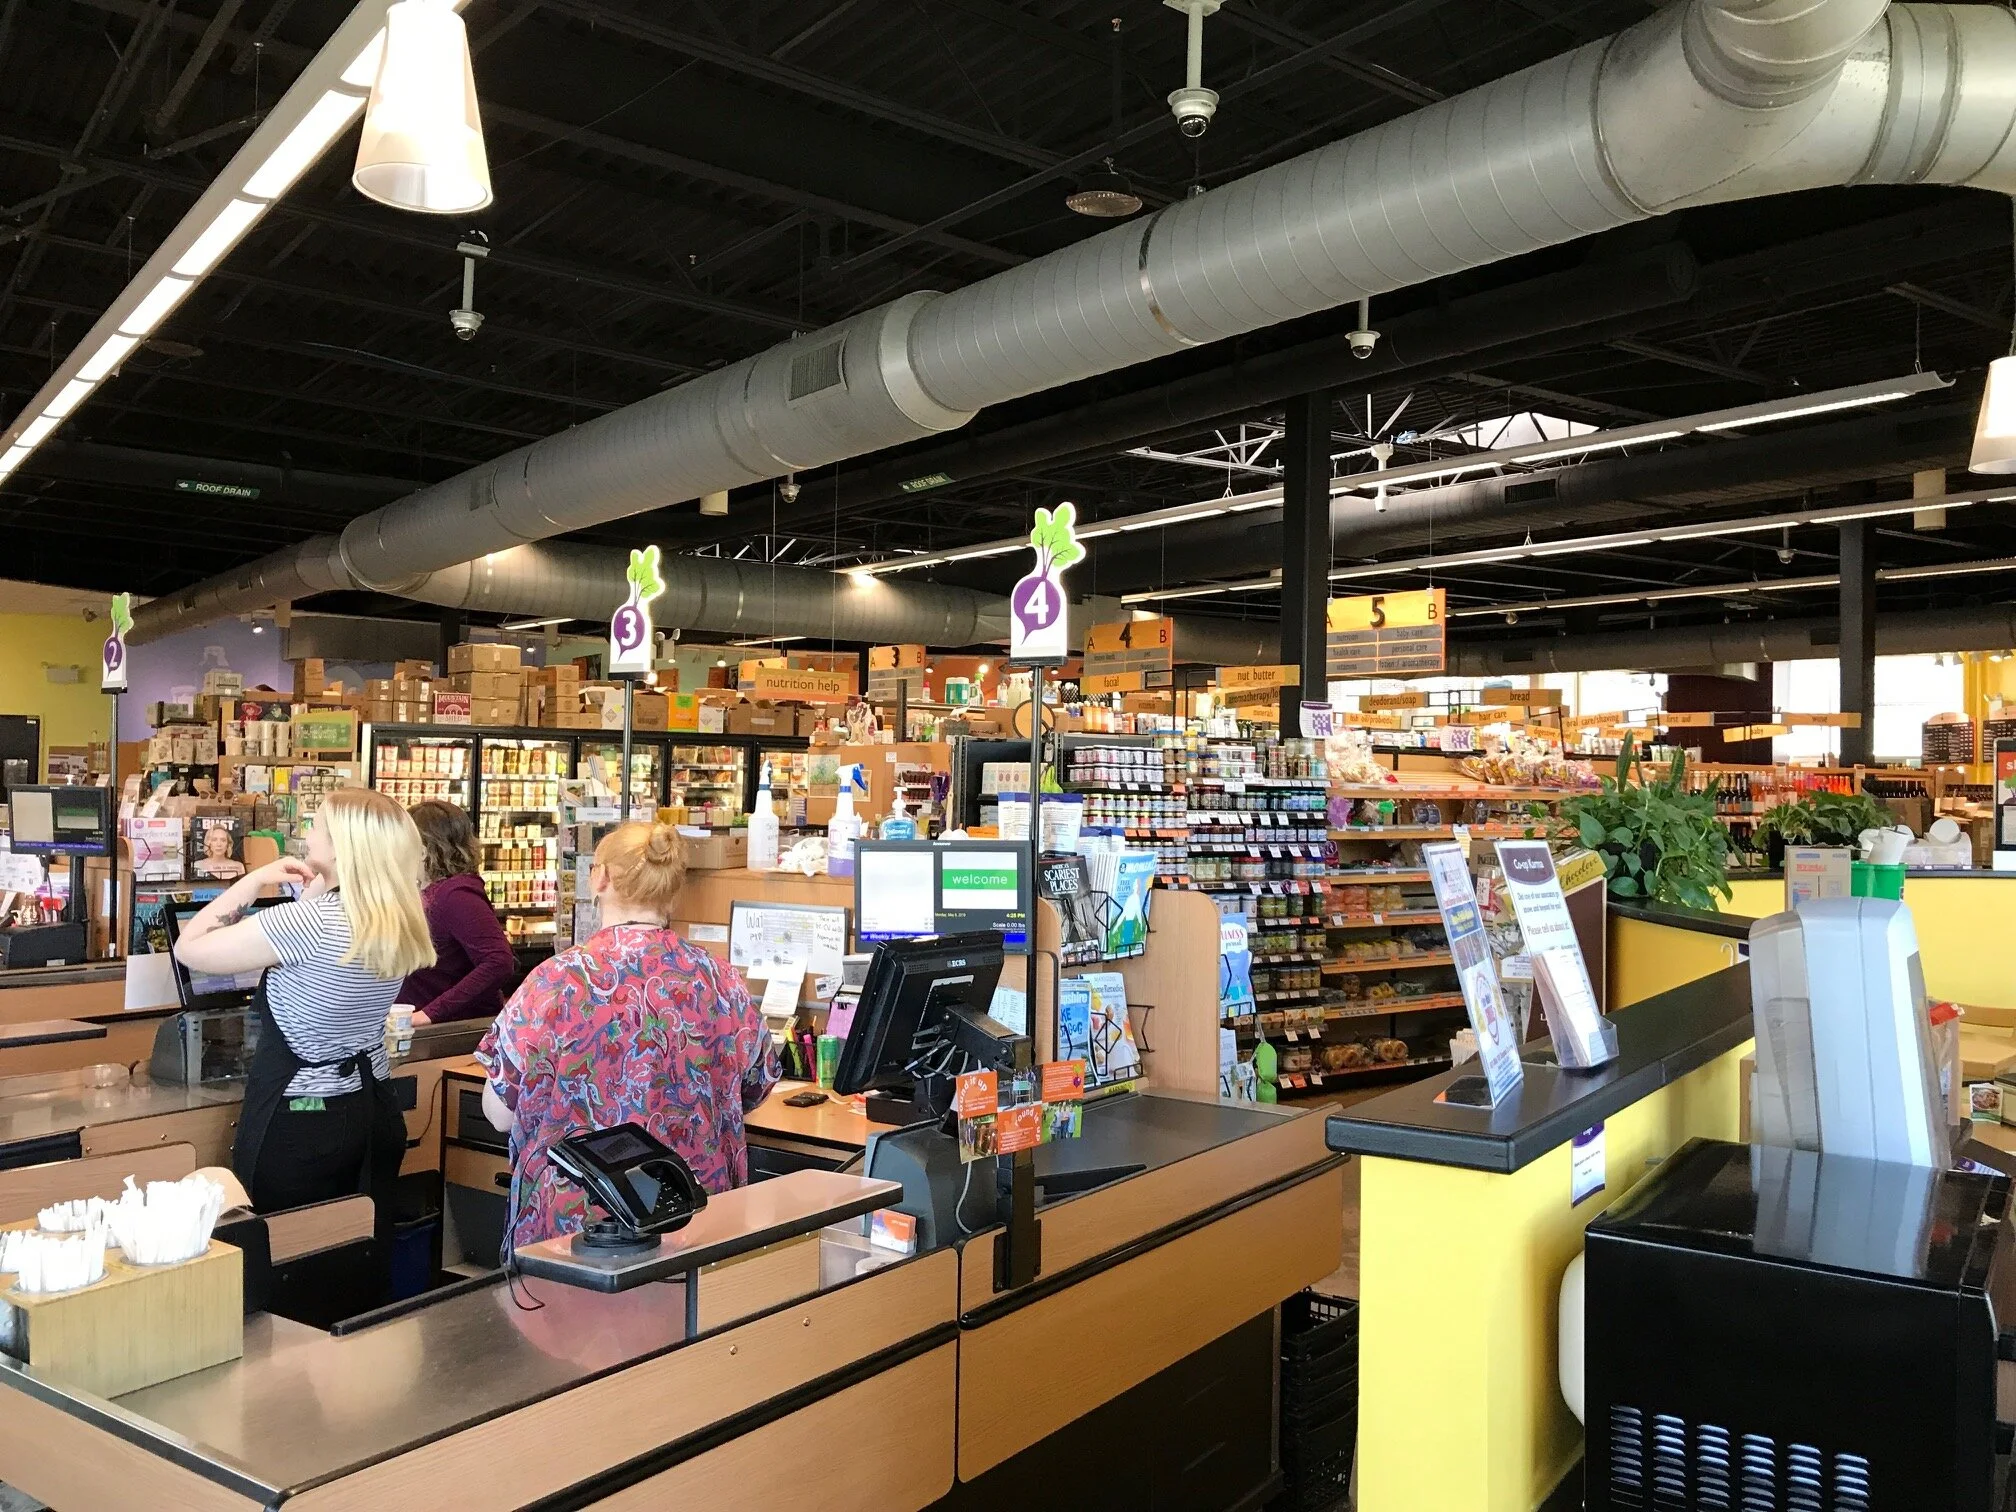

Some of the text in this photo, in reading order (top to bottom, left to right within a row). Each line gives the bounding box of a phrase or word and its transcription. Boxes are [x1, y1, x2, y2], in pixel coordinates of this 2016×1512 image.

[195, 483, 251, 497] ROOF DRAIN
[1024, 581, 1049, 625] 4
[1370, 596, 1386, 628] 5
[1428, 603, 1437, 619] B
[621, 610, 637, 647] 3
[1119, 622, 1132, 648] 4
[1087, 637, 1095, 650] A
[1160, 630, 1167, 643] B
[109, 641, 118, 668] 2
[891, 646, 900, 668] 3
[916, 651, 922, 664] B
[870, 656, 876, 668] A
[1237, 668, 1275, 680] nut butter
[766, 679, 840, 694] nutrition help
[1103, 676, 1119, 687] facial
[1509, 691, 1530, 701] bread
[1478, 711, 1507, 721] hair care
[1566, 714, 1620, 728] oral care/shaving
[952, 874, 1008, 885] welcome
[1044, 867, 1080, 882] SCARIEST
[1049, 879, 1079, 892] PLACES
